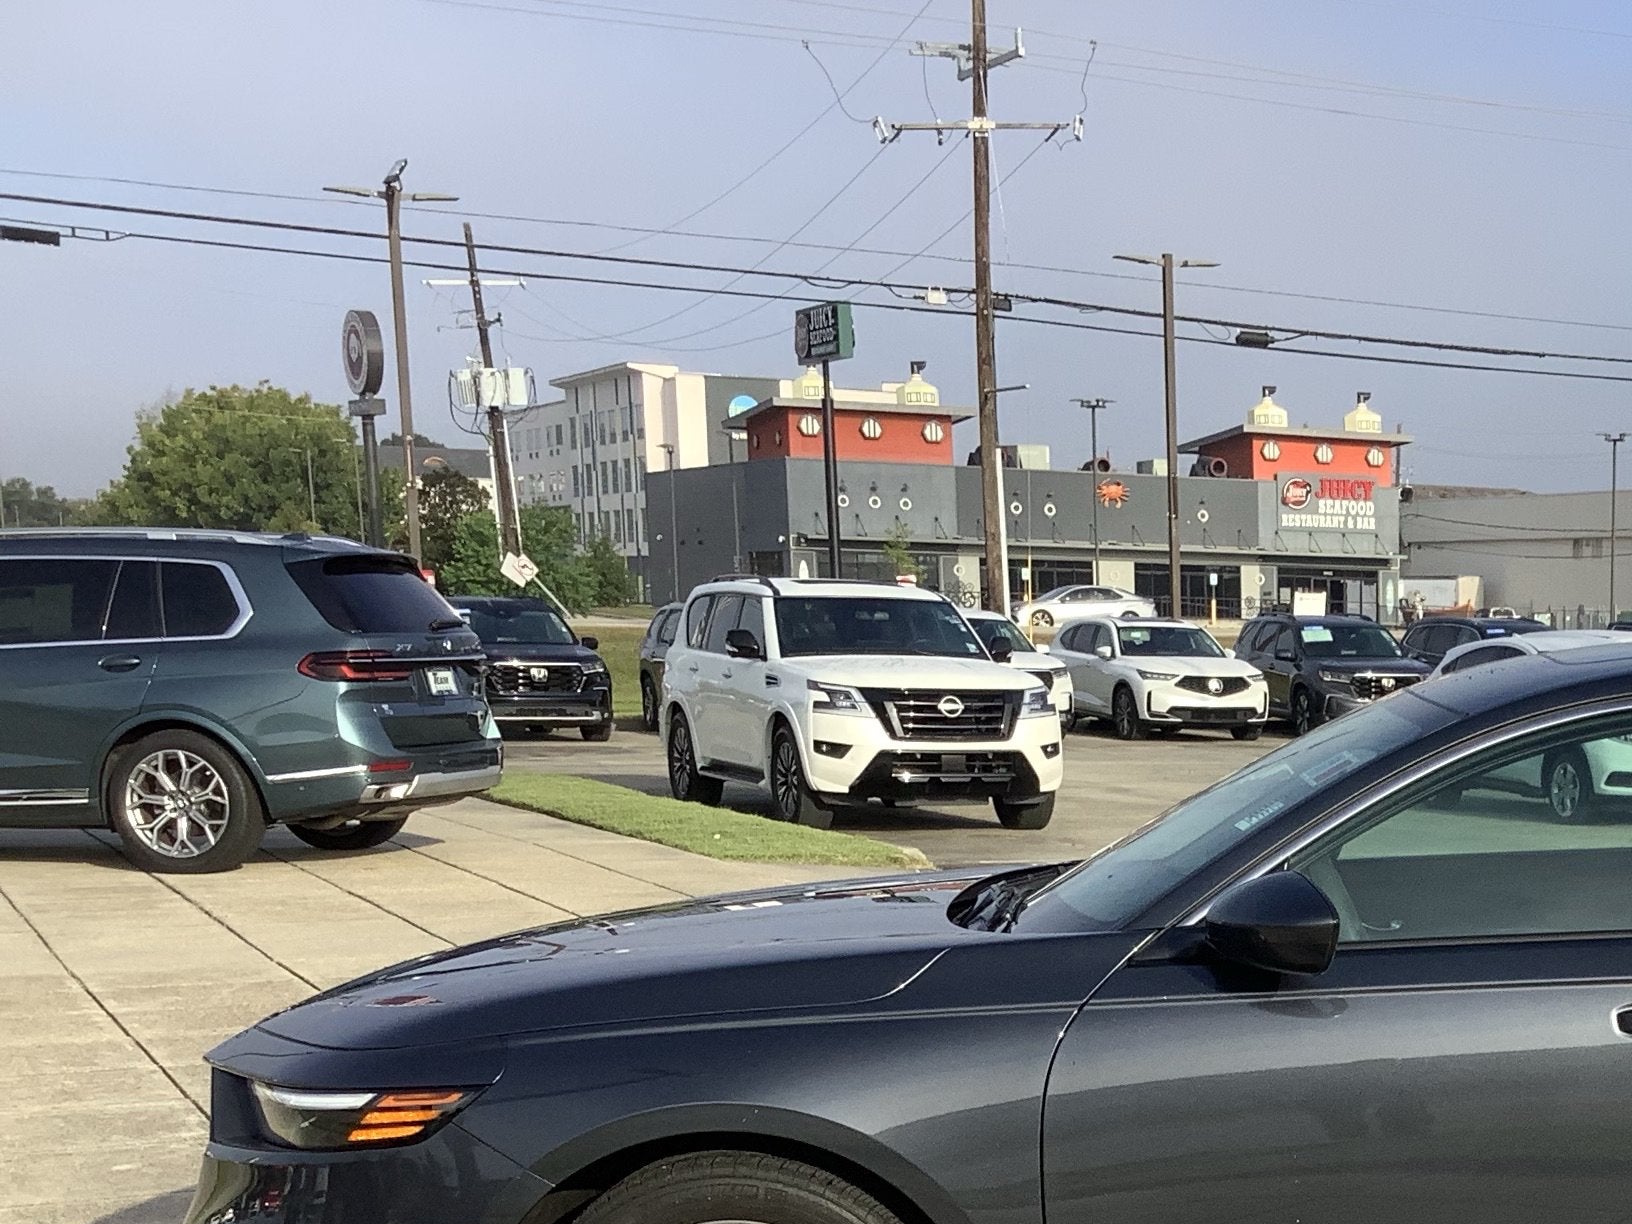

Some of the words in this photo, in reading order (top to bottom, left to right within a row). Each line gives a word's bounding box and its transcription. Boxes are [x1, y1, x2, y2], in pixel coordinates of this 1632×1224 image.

[809, 305, 833, 331] JUICY
[1315, 478, 1373, 501] JUICY
[1318, 499, 1375, 516] SEAFOOD
[1281, 513, 1345, 529] RESTAURANT
[1347, 516, 1354, 529] &
[1356, 516, 1376, 530] BAR
